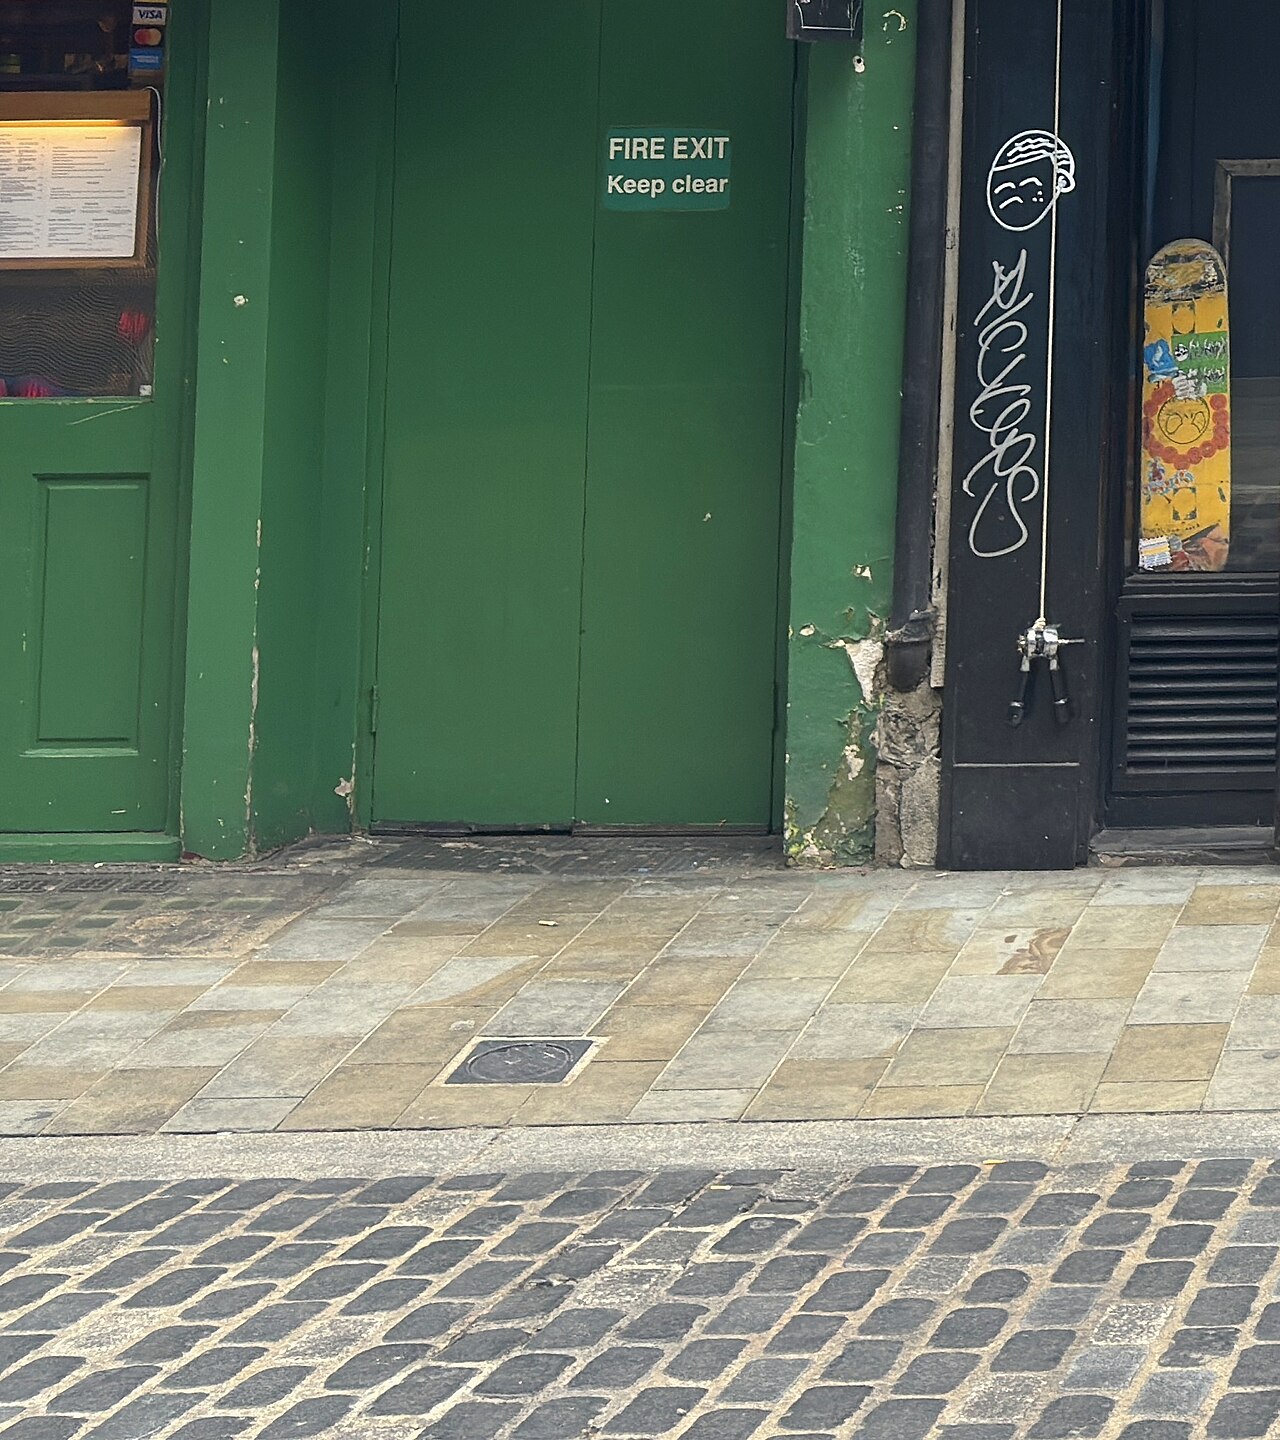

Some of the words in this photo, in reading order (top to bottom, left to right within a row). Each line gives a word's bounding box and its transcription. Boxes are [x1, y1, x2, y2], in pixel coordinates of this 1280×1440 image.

[139, 10, 163, 19] VISA
[609, 137, 666, 160] FIRE
[672, 137, 730, 159] EXIT
[607, 175, 665, 198] Keep
[672, 175, 729, 193] clear
